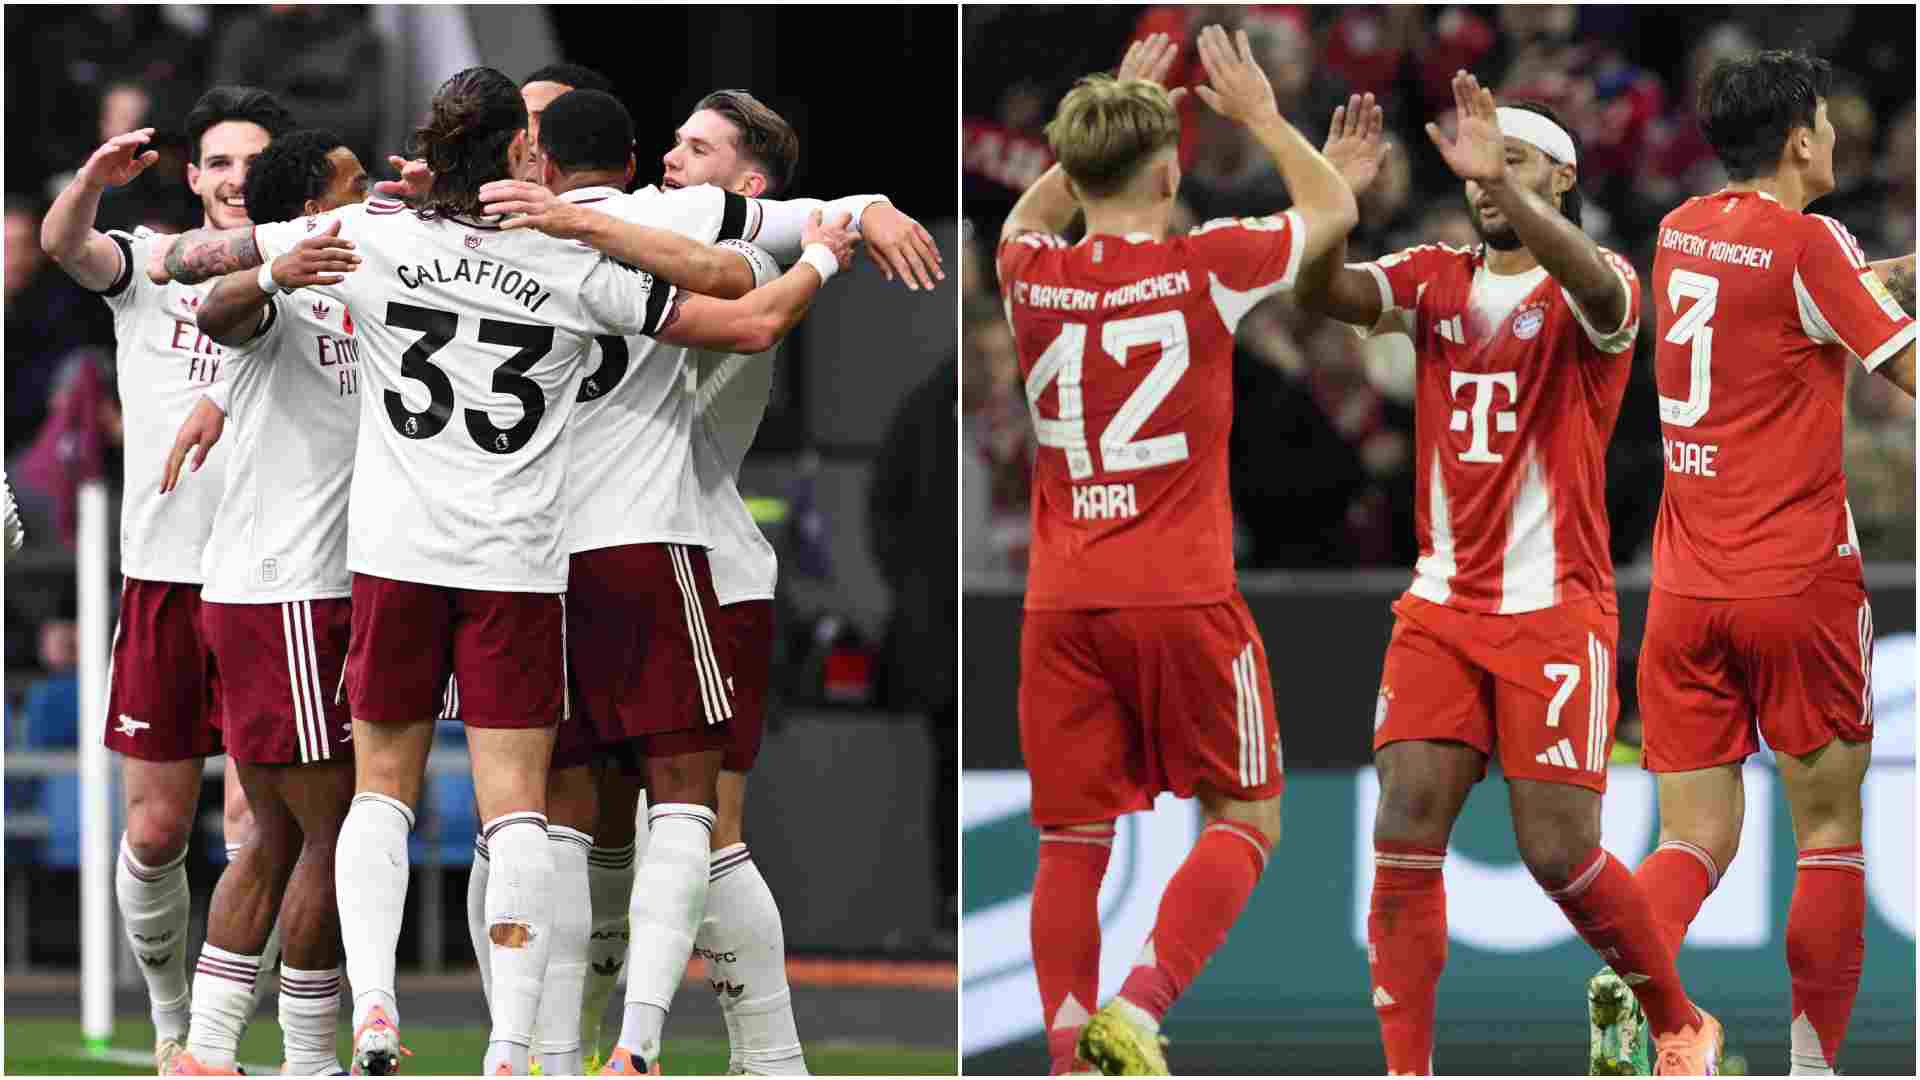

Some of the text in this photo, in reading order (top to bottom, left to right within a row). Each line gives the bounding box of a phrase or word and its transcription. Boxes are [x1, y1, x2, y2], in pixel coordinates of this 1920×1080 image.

[1663, 228, 1707, 257] BAYERN
[397, 258, 552, 313] CALAFIORI
[1029, 283, 1100, 311] BAYERN
[188, 357, 220, 384] FLY
[1659, 268, 1720, 428] 3
[383, 301, 560, 455] 33
[1025, 310, 1190, 480] 42
[1071, 484, 1139, 520] KARL
[1543, 663, 1581, 727] 7
